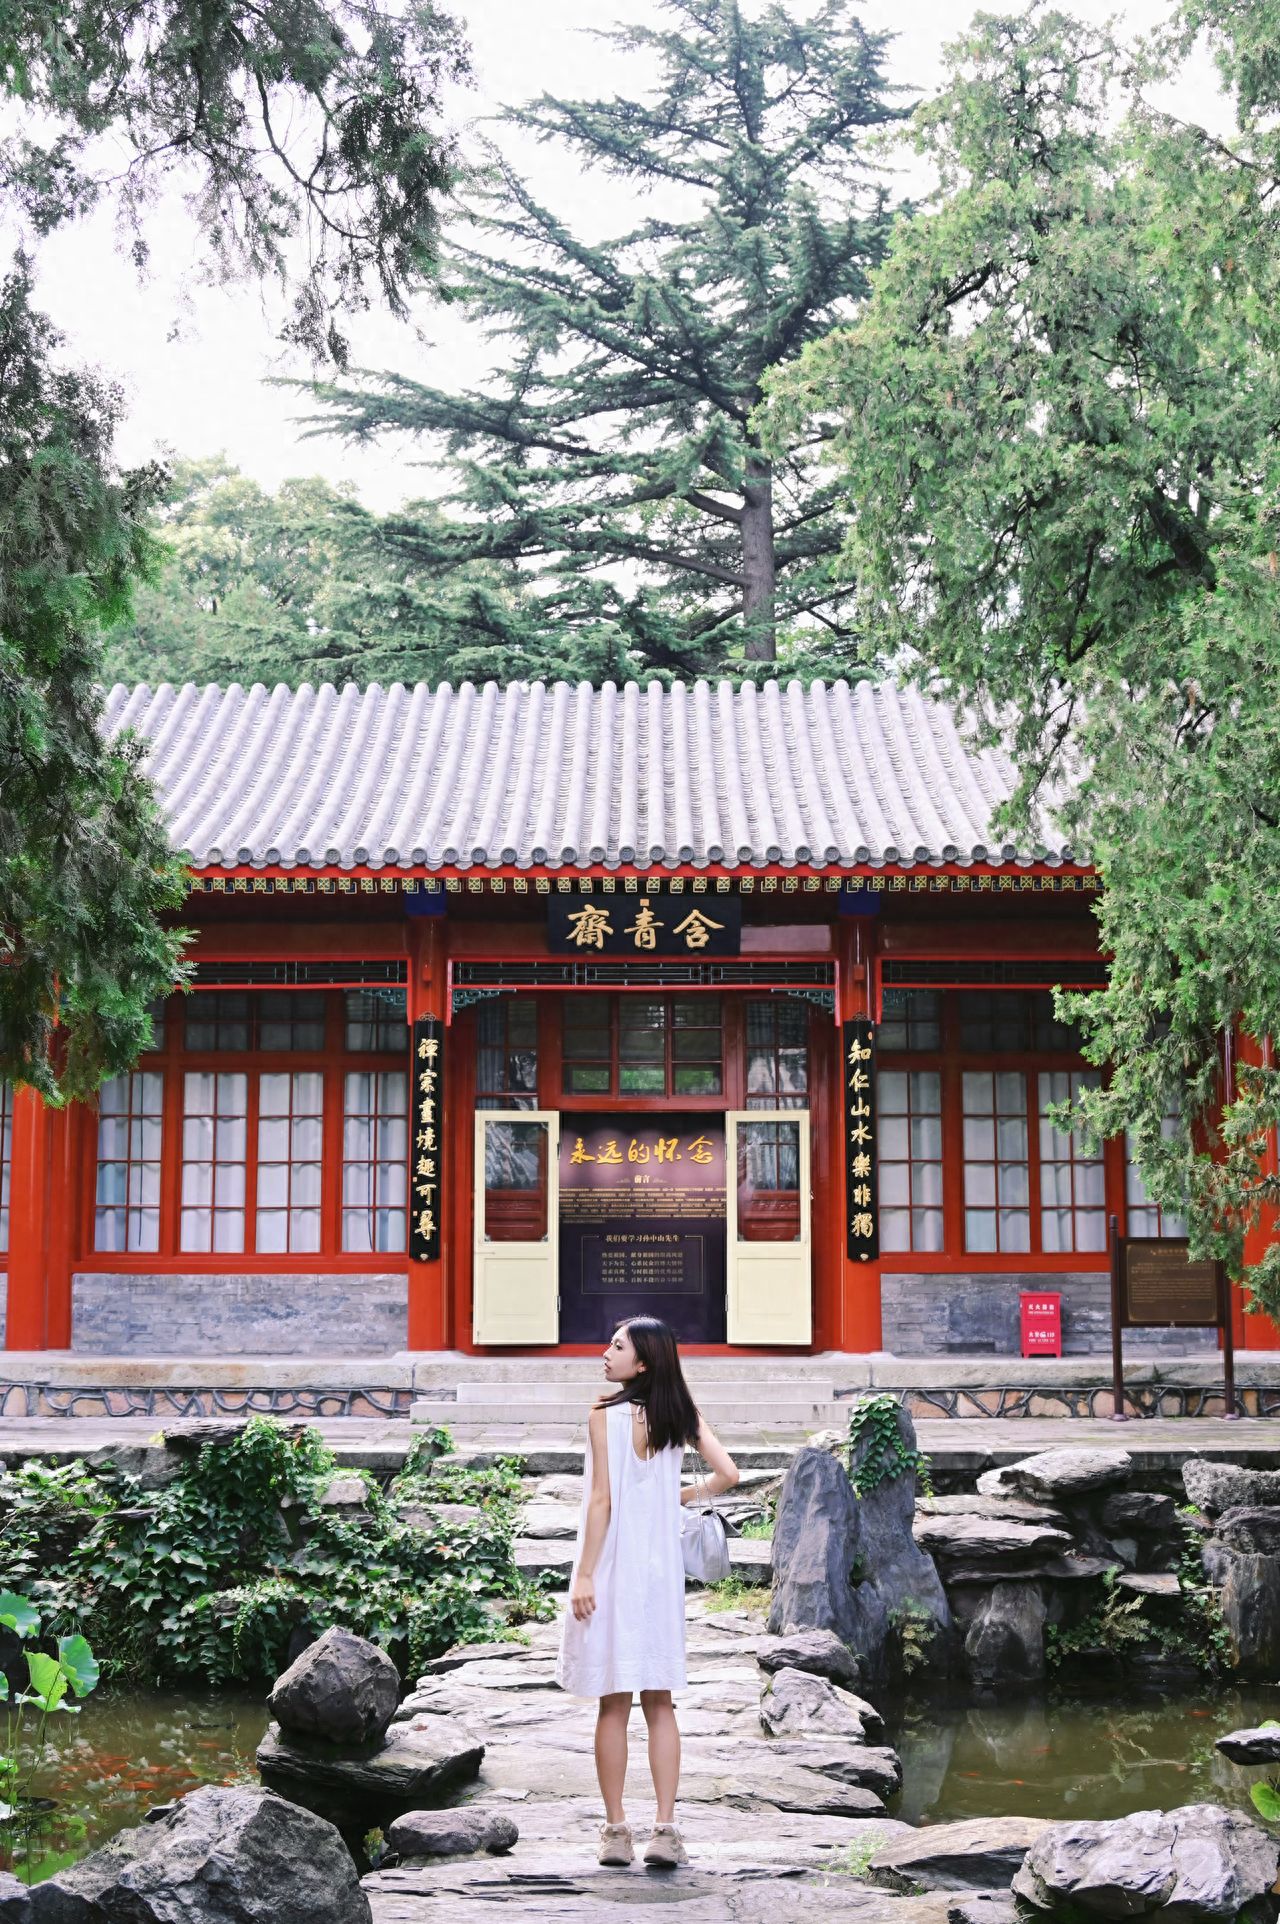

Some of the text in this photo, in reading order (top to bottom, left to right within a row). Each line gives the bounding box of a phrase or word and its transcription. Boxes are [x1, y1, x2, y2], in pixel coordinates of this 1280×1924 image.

[569, 1135, 714, 1165] 永远的怀念
